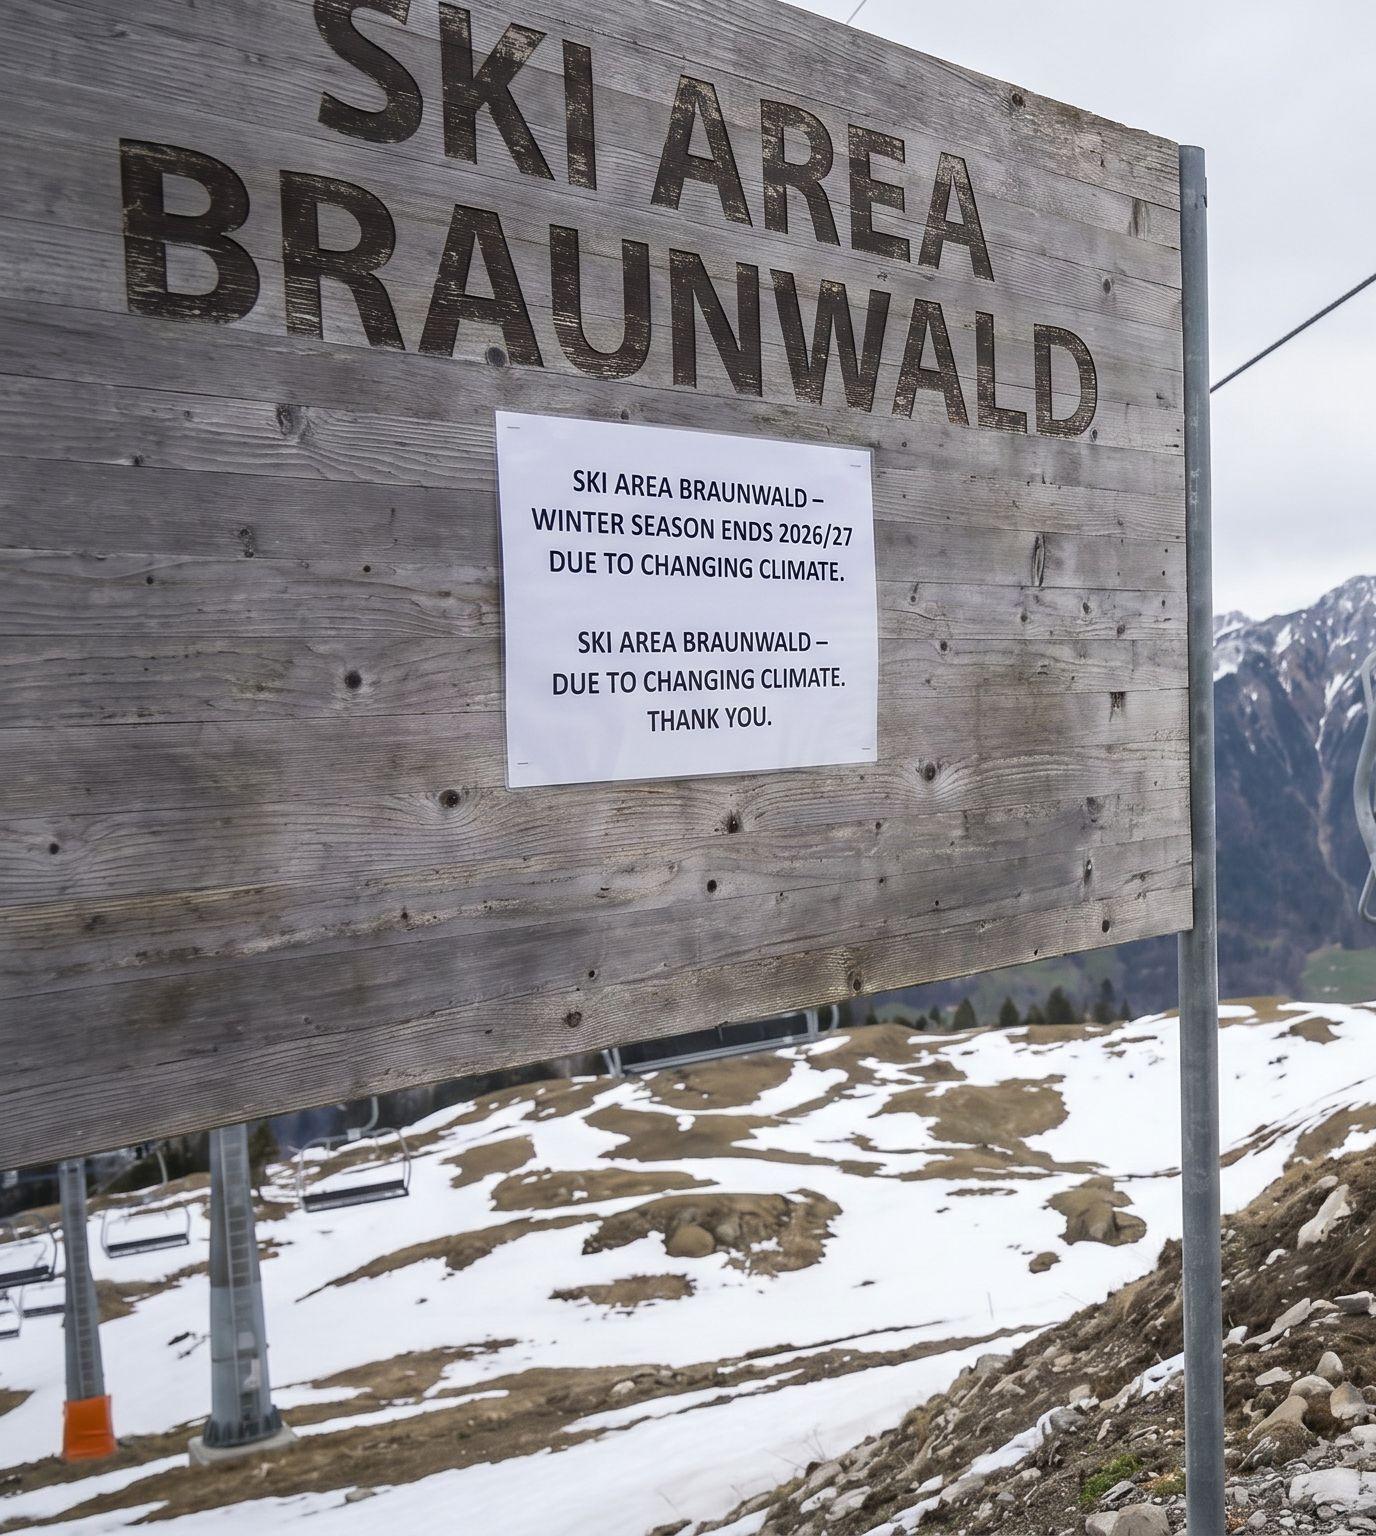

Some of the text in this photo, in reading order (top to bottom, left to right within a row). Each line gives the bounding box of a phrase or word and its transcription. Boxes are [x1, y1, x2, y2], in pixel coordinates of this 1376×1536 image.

[314, 0, 995, 282] SKI AREA
[119, 138, 1098, 438] BRAUNWALD
[573, 469, 607, 494] SKI
[614, 473, 674, 499] AREA
[679, 477, 808, 508] BRAUNWALD
[531, 507, 853, 550] WINTER SEASON ENDS 2026/27
[549, 550, 845, 582] DUE TO CHANGING CLIMATE.
[577, 630, 612, 654] SKI
[619, 631, 678, 654] AREA
[683, 631, 811, 653] BRAUNWALD
[552, 667, 846, 696] DUE TO CHANGING CLIMATE.
[646, 705, 772, 732] THANK YOU.
